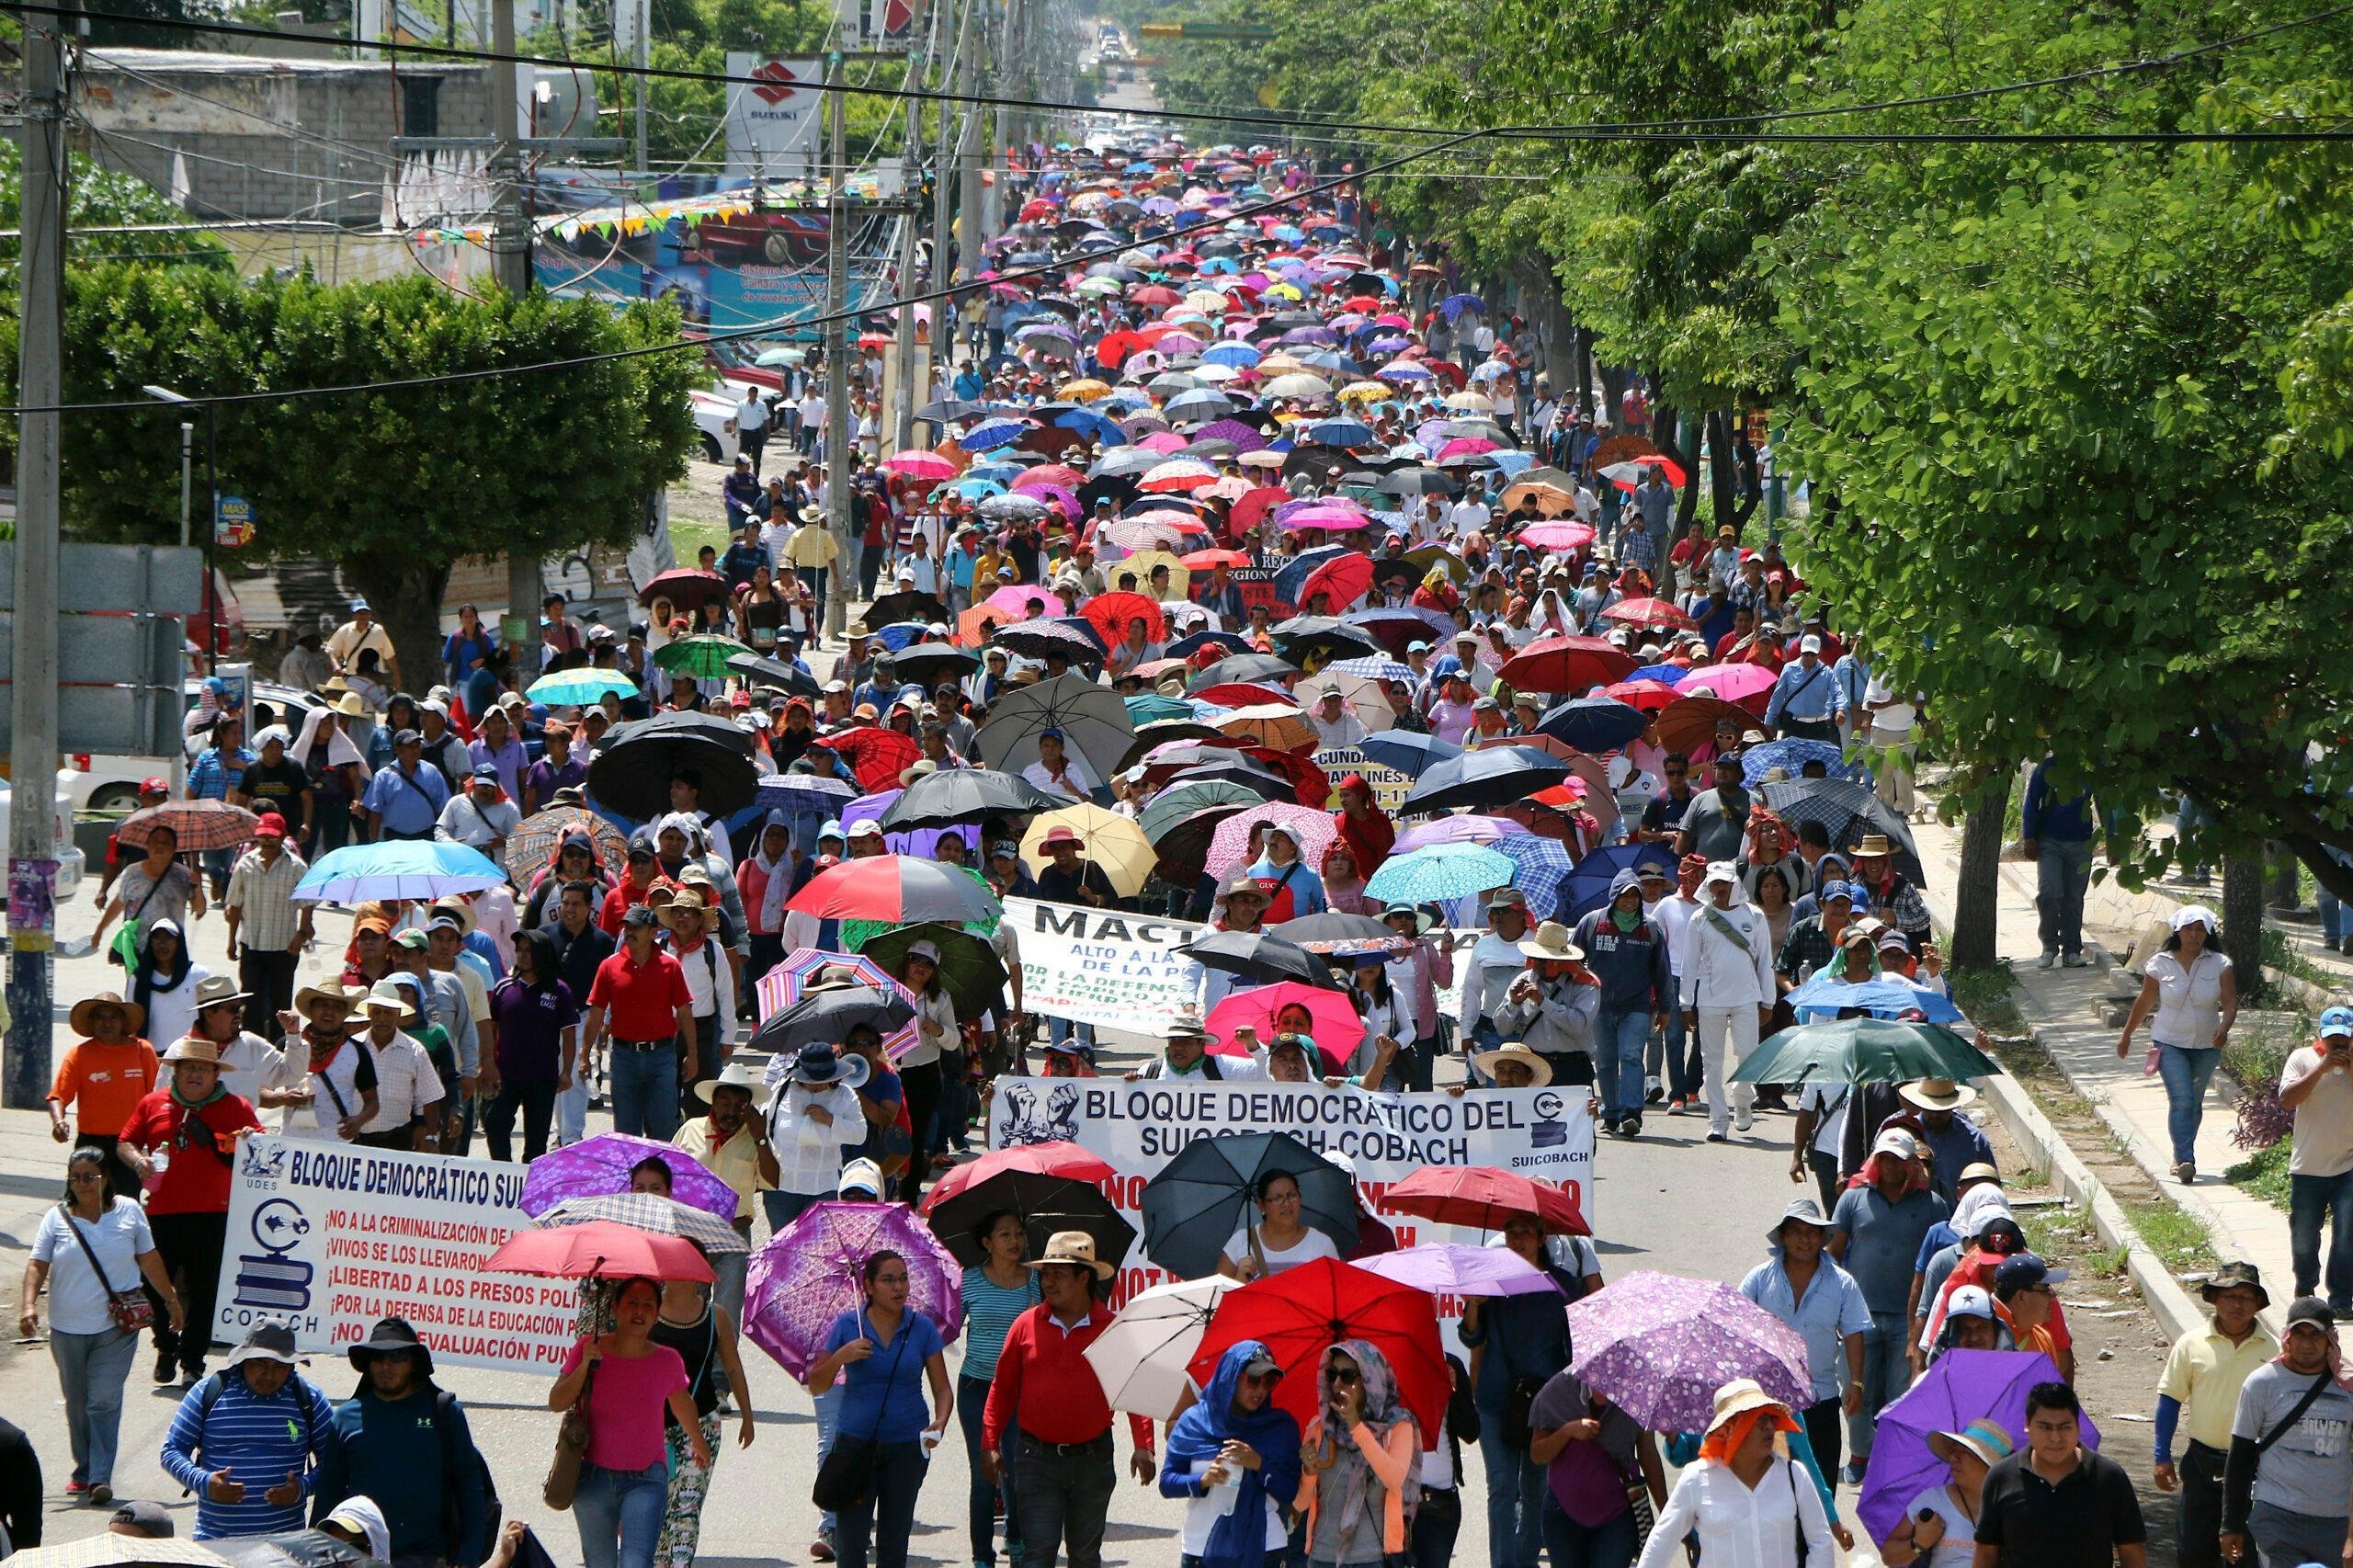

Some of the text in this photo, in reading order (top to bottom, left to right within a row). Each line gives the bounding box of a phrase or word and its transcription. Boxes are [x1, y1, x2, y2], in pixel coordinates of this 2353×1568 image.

[751, 111, 796, 120] SUZUKI
[540, 256, 582, 270] Sego
[1368, 768, 1403, 783] INÉS
[1035, 904, 1193, 944] MACT
[1071, 944, 1175, 964] ALTO A LA
[1083, 960, 1111, 972] DE
[1122, 965, 1153, 977] LA
[1022, 963, 1178, 993] OR LA DEFENS
[1085, 1089, 1526, 1131] BLOQUE DEMOCRÁTICO DEL
[1511, 1150, 1589, 1169] SUICOBACH
[246, 1178, 278, 1191] UDES
[290, 1151, 524, 1210] BLOQUE DEMOCRÁTICO SUI
[324, 1210, 347, 1233] ¡NO
[347, 1211, 358, 1232] A
[361, 1212, 377, 1233] LA
[380, 1214, 487, 1244] CRIMINALIZACIÓN
[490, 1225, 511, 1246] DE
[326, 1237, 487, 1272] ¡VIVOS SE LOS LLEVARON
[327, 1266, 585, 1311] ¡LIBERTAD A LOS PRESOS POLÍT
[330, 1294, 362, 1316] ¡POR
[365, 1297, 381, 1317] LA
[385, 1298, 445, 1324] DEFENSA
[449, 1306, 465, 1325] DE
[468, 1308, 484, 1327] LA
[488, 1310, 564, 1336] EDUCACIÓN
[330, 1321, 364, 1346] ¡NO
[417, 1331, 531, 1362] EVALUACIÓN
